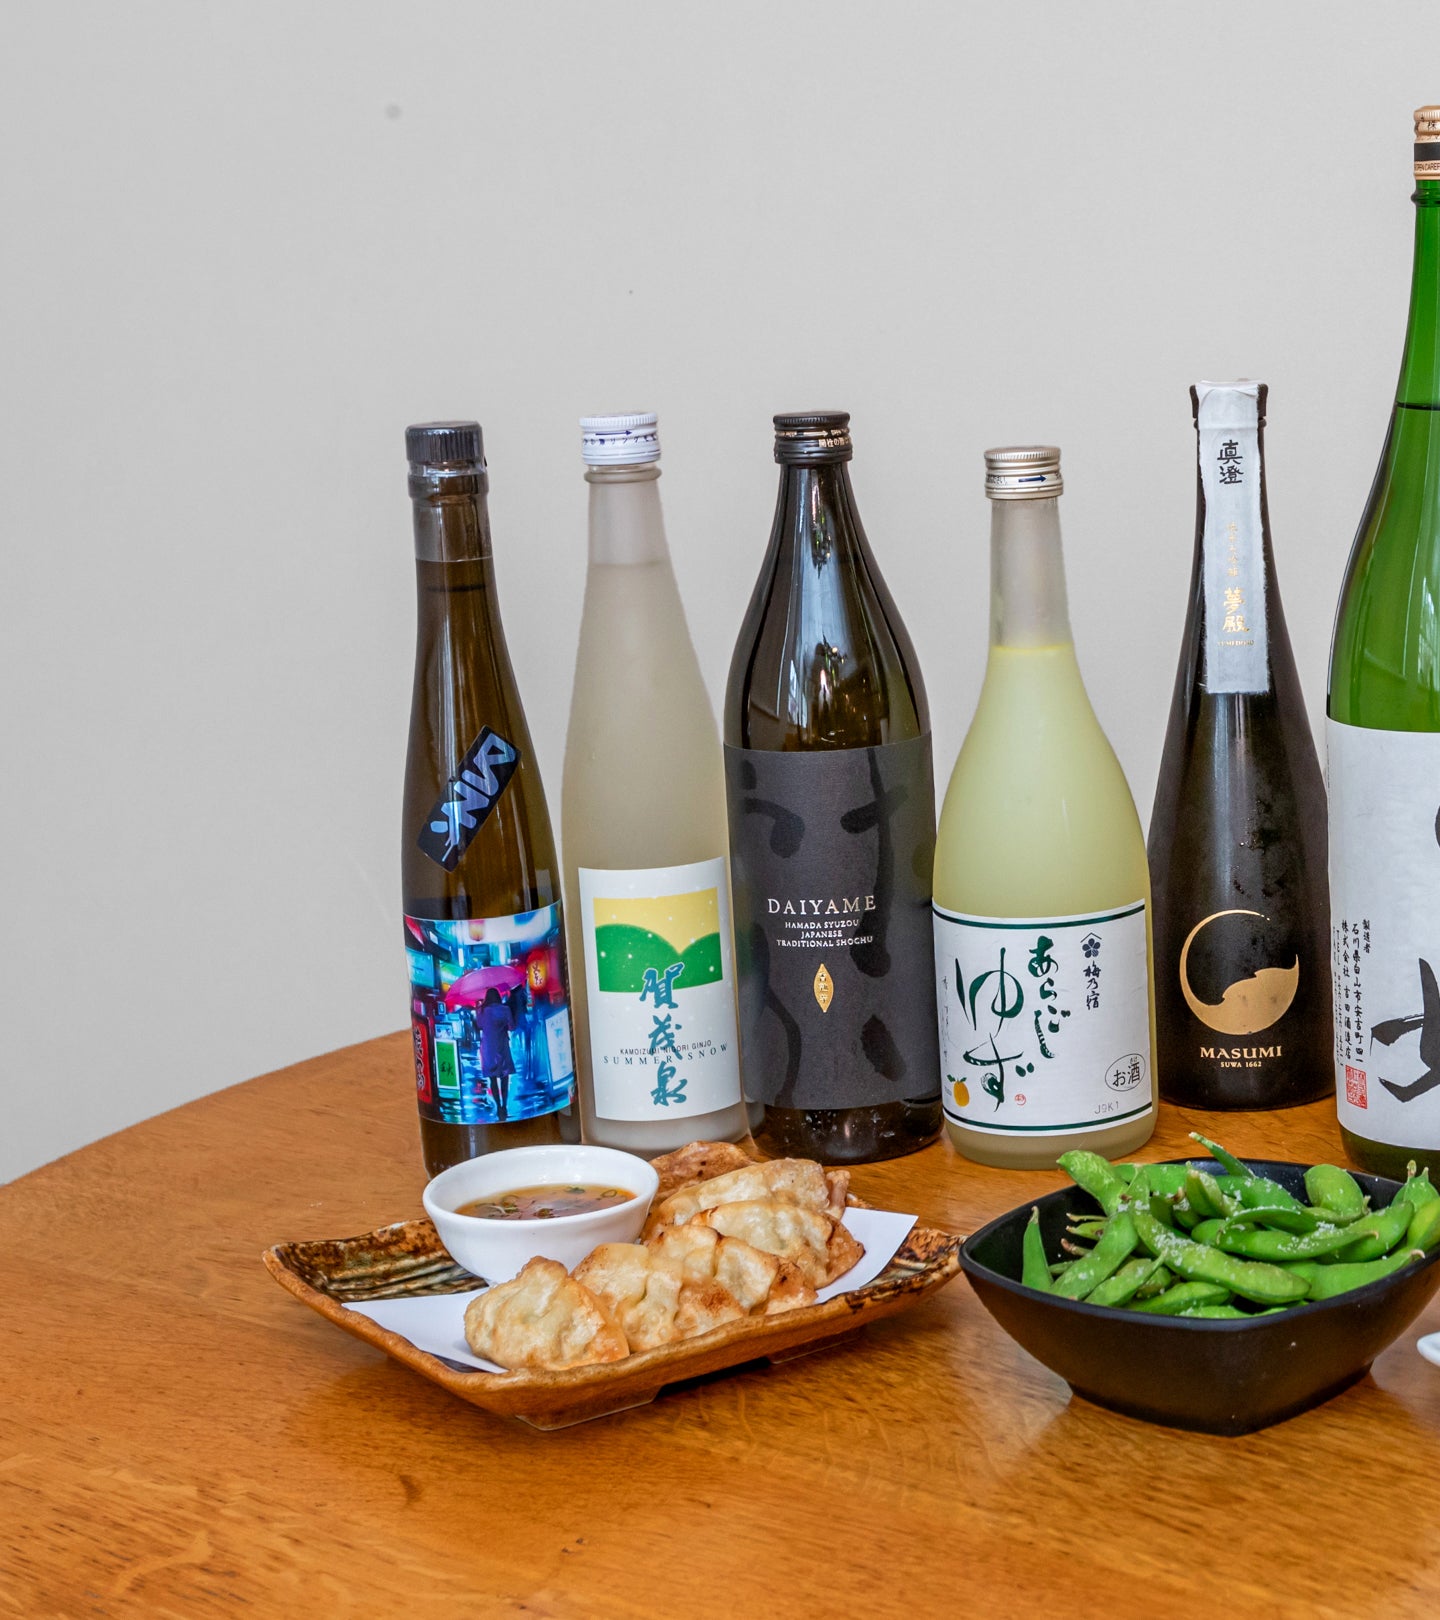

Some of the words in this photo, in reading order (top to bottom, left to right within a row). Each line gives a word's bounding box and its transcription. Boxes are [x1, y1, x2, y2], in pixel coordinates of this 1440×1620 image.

[1217, 439, 1244, 485] 真澄
[767, 895, 876, 915] DAIYAME
[785, 921, 822, 929] HAMADA
[824, 919, 860, 929] SYUZOU
[776, 939, 834, 948] TRADITIONAL
[836, 935, 874, 947] SHOCHU
[801, 930, 843, 939] JAPANESE
[1082, 961, 1102, 1011] 梅乃宿
[639, 961, 688, 1107] 賀茂泉
[692, 1039, 713, 1050] GINJO
[1200, 1045, 1283, 1059] MASUMI
[603, 1054, 673, 1066] SUMMER
[687, 1043, 729, 1061] SNOW
[1245, 1060, 1262, 1068] 1662
[1112, 1061, 1141, 1088] お酒
